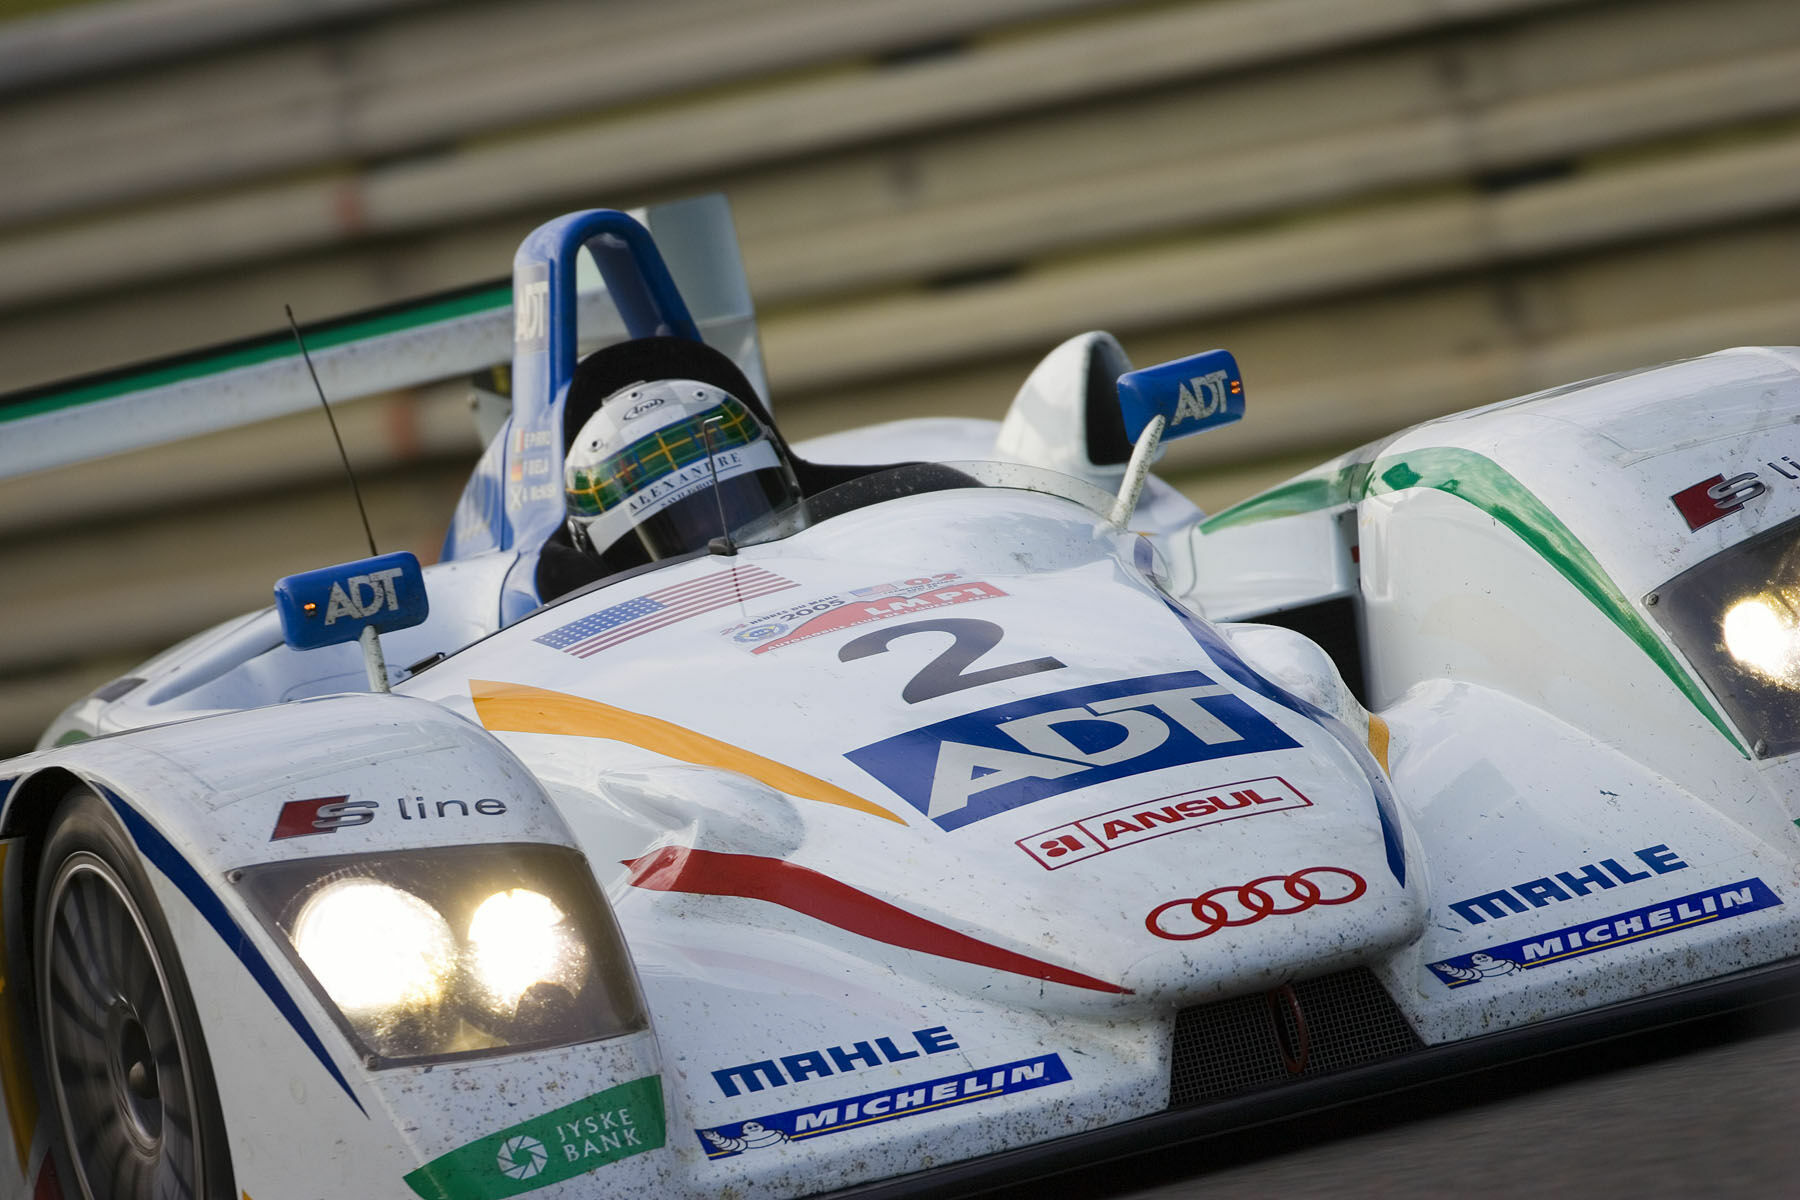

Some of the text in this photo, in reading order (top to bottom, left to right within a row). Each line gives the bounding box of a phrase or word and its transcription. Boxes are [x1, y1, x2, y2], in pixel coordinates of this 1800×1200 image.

[514, 281, 549, 343] ADT
[1170, 369, 1228, 426] ADT
[628, 451, 741, 511] ALEXANDRE
[1706, 472, 1766, 510] S
[324, 567, 404, 626] ADT
[779, 599, 846, 622] 2005
[838, 618, 1067, 705] 2
[926, 684, 1245, 820] ADT
[312, 796, 507, 829] S line
[1102, 789, 1283, 840] ANSUL
[1447, 843, 1690, 926] MAHLE
[1521, 886, 1755, 961] MICHELIN
[710, 1025, 961, 1099] MAHLE
[556, 1108, 633, 1143] JYSKE
[794, 1061, 1047, 1132] MICHELIN
[563, 1127, 643, 1162] BANK
